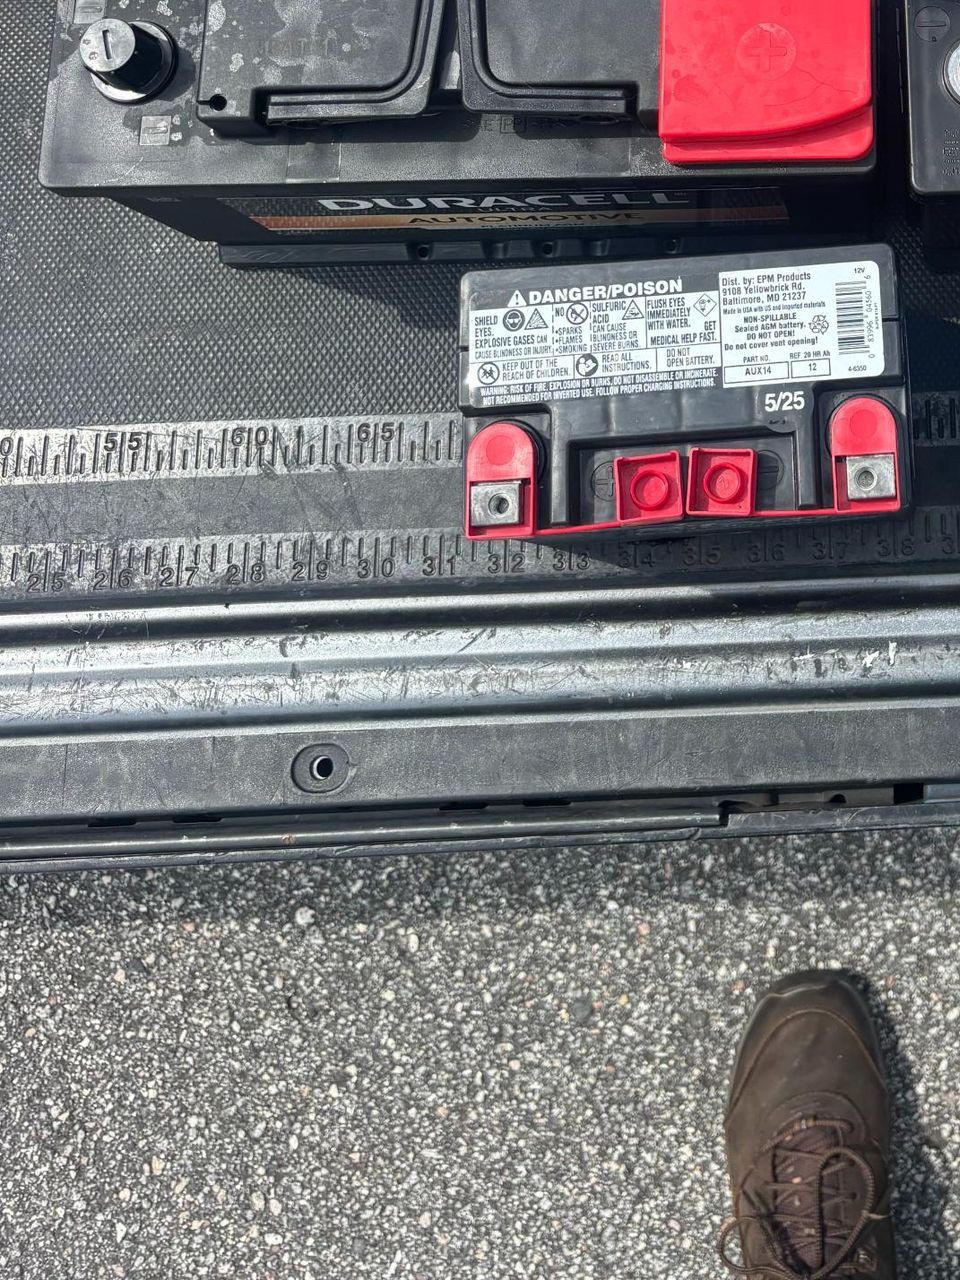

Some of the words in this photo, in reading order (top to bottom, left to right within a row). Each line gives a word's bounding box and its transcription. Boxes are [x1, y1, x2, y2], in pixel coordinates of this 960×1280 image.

[318, 193, 688, 211] DURACELL
[406, 212, 645, 226] AUTOMOTIVE
[721, 277, 740, 286] Dist.
[742, 276, 754, 285] by:
[756, 274, 774, 284] EPM
[776, 272, 811, 282] Products
[528, 279, 683, 306] DANGER/POISON
[722, 286, 742, 296] 9108
[743, 283, 789, 294] Yellowbrick
[791, 282, 805, 290] Rd.
[744, 367, 772, 375] AUX14
[808, 363, 817, 371] 12
[764, 391, 805, 413] 5/25
[357, 423, 395, 442] 65
[27, 574, 65, 592] 25
[94, 570, 132, 590] 26
[160, 567, 198, 587] 27
[227, 564, 265, 584] 28
[292, 561, 330, 580] 29
[357, 558, 395, 578] 30
[422, 555, 457, 575] 31
